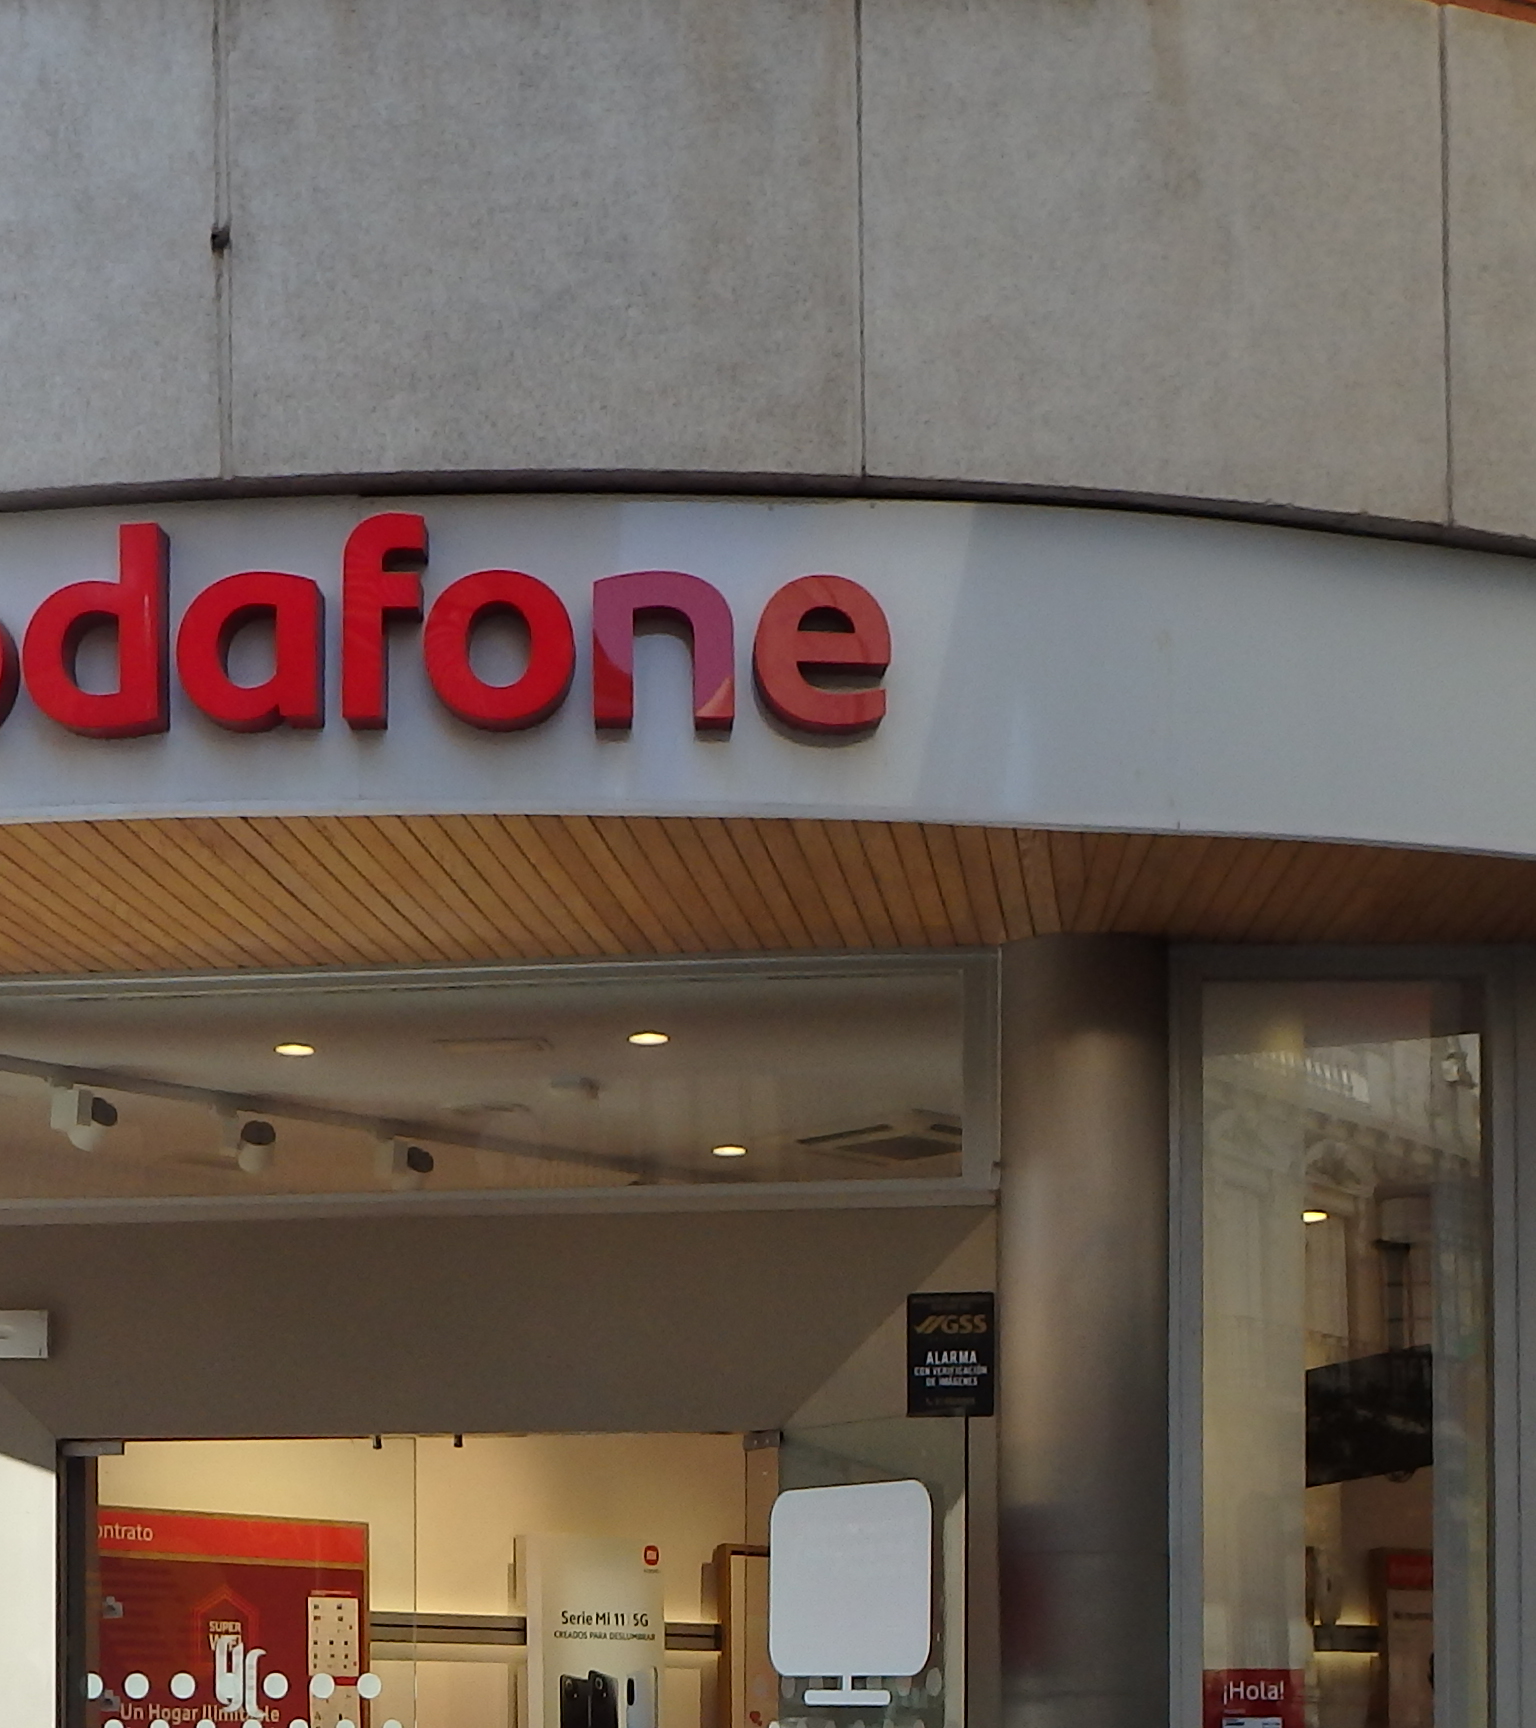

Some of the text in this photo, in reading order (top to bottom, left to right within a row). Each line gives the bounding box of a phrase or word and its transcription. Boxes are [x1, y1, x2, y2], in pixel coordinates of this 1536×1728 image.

[925, 1350, 977, 1365] ALARMA
[561, 1610, 593, 1626] Serie
[614, 1612, 625, 1627] 11
[633, 1613, 649, 1627] 5G
[209, 1621, 242, 1633] SUPER
[553, 1630, 588, 1640] CREADOS
[589, 1631, 608, 1640] PARA
[1223, 1680, 1284, 1705] ¡Hola!
[120, 1703, 144, 1720] Un
[148, 1703, 199, 1726] Hogar
